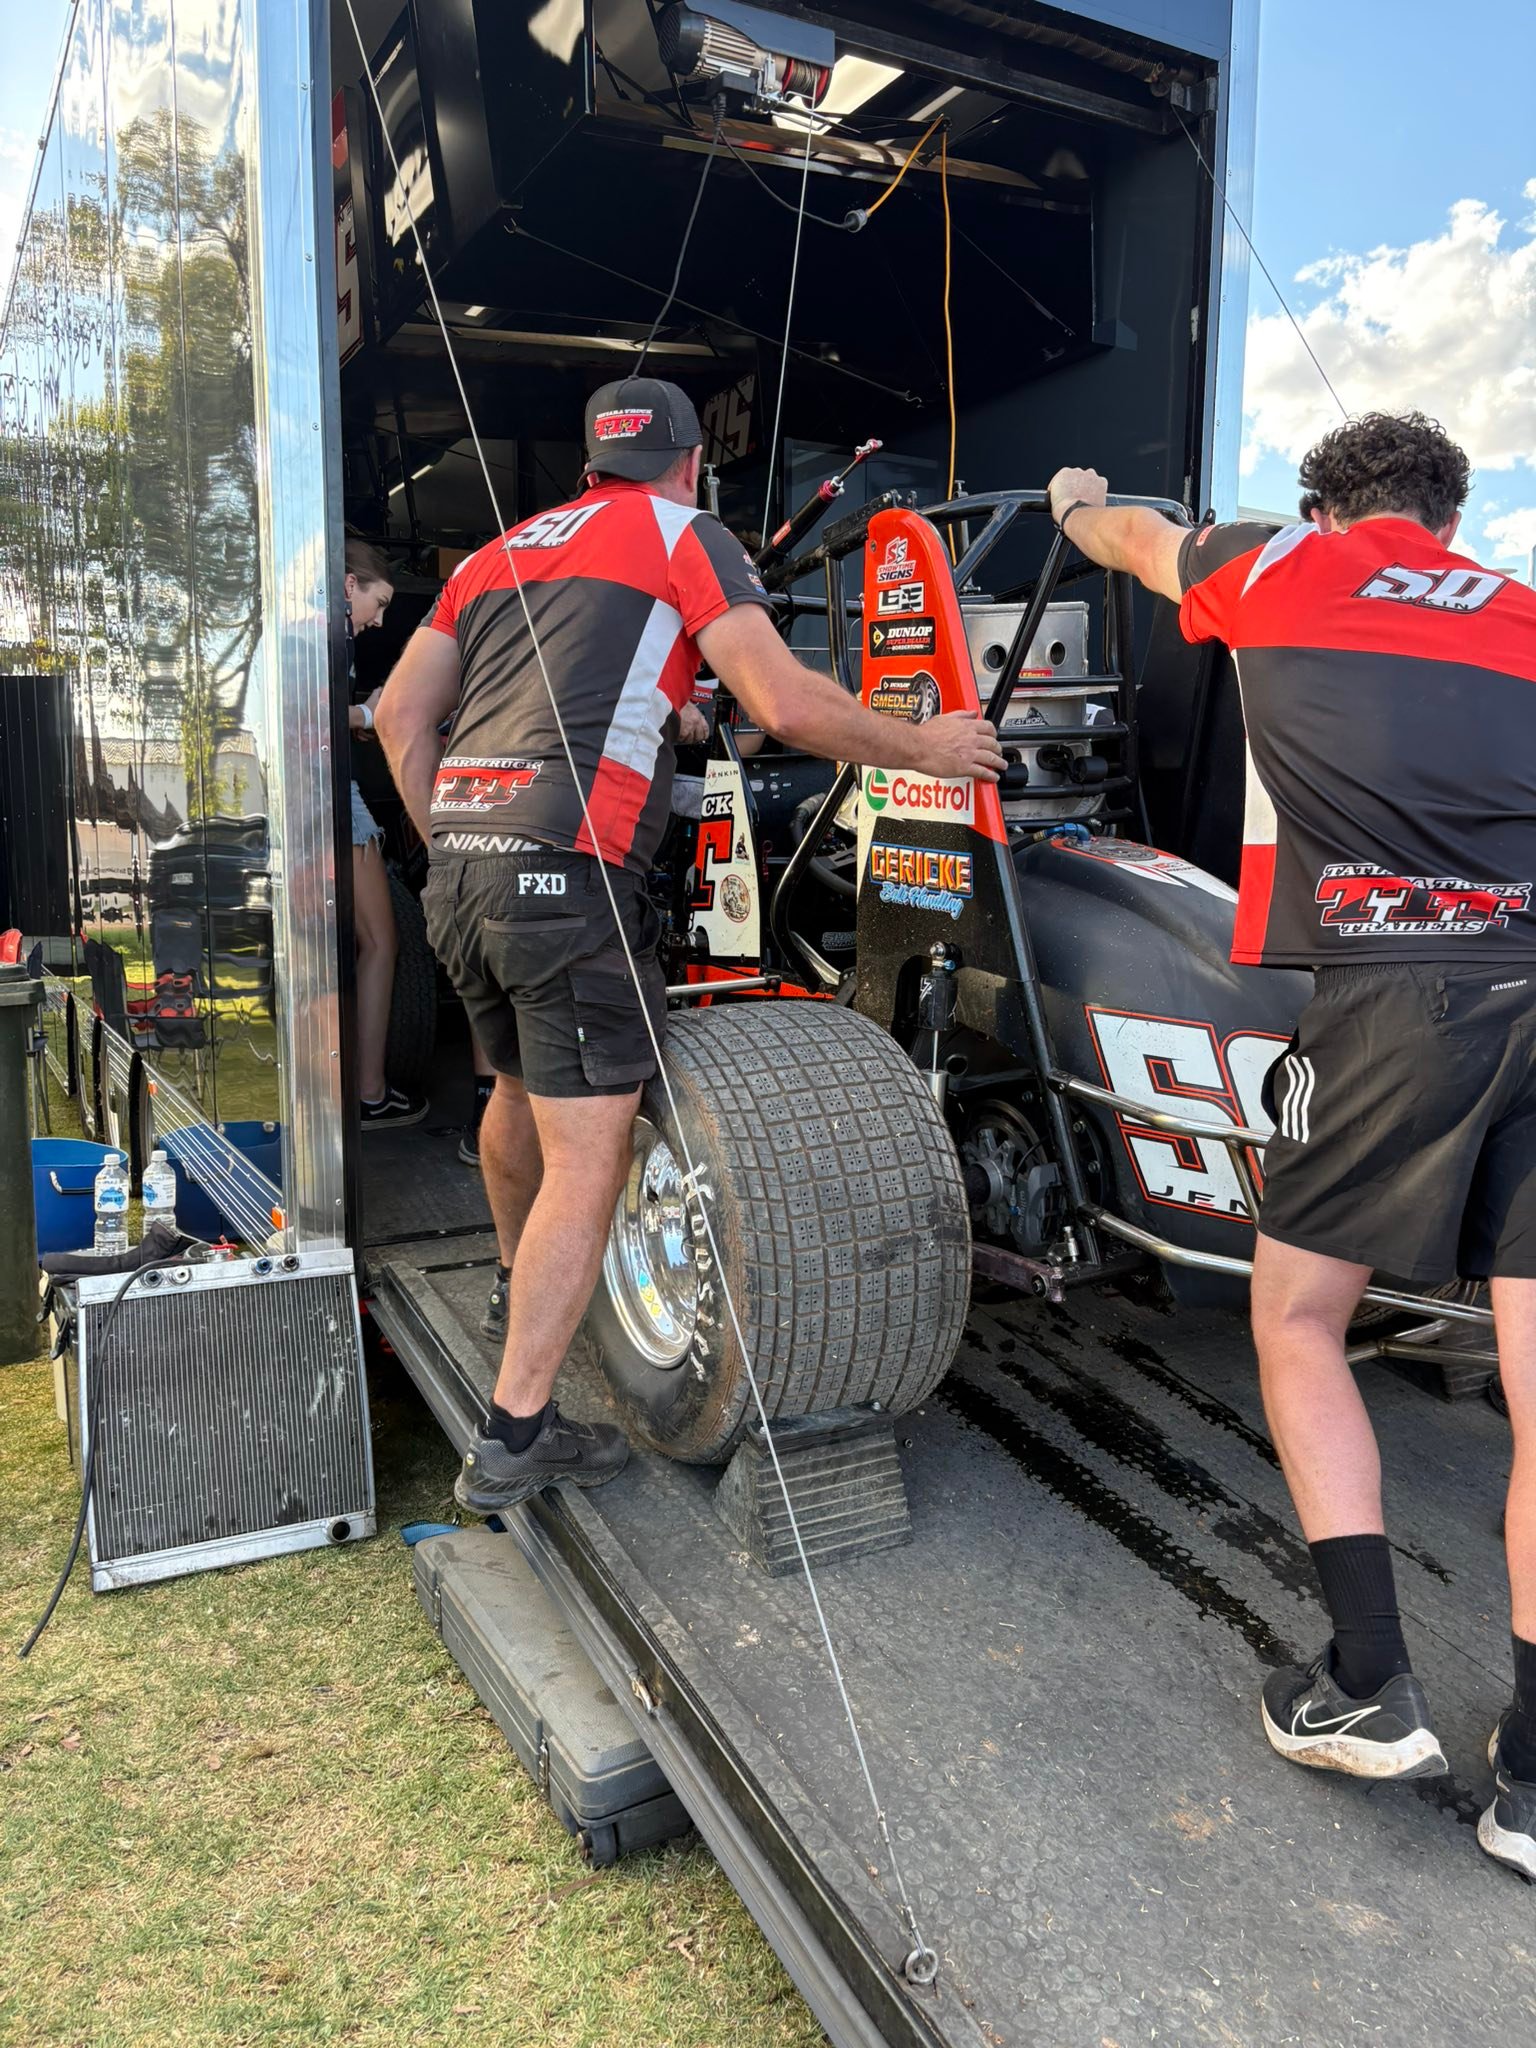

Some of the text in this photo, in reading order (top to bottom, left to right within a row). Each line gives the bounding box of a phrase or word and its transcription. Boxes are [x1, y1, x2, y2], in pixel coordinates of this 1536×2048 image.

[879, 562, 914, 573] SHOWTIME
[878, 569, 913, 581] SIGNS
[1354, 564, 1507, 613] 50
[887, 626, 933, 638] DUNLOP
[872, 694, 921, 708] SMEDLEY
[892, 777, 970, 811] Castrol
[871, 845, 971, 894] GERICKE
[1342, 920, 1485, 934] TRAILERS
[1490, 979, 1528, 992] AEROREADY
